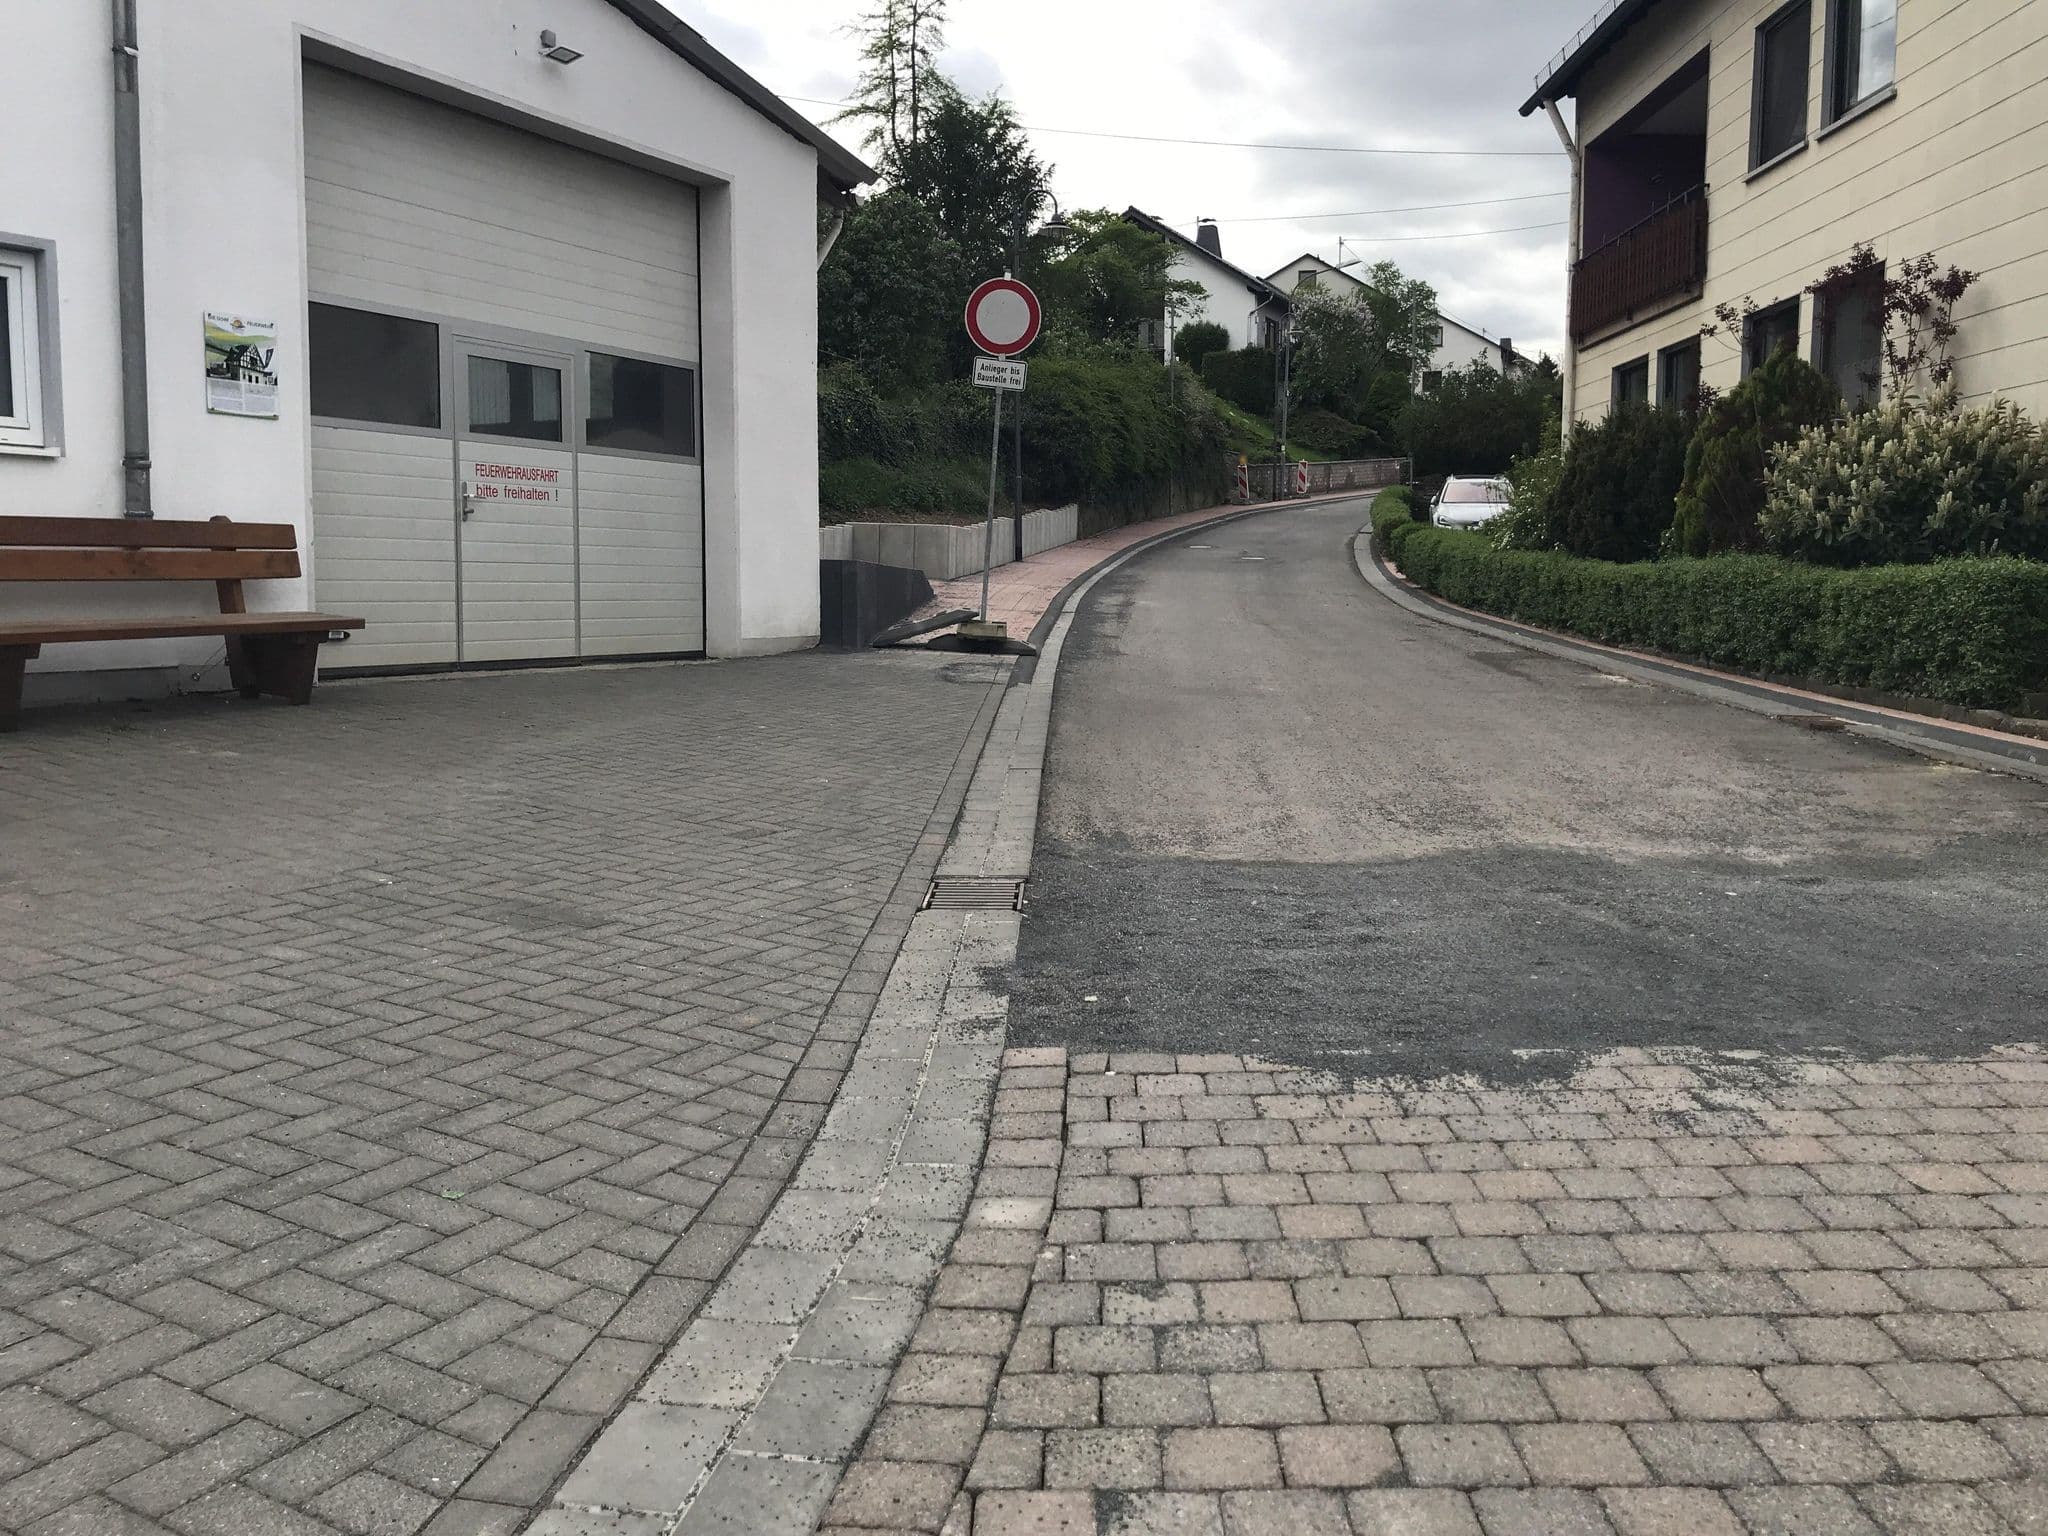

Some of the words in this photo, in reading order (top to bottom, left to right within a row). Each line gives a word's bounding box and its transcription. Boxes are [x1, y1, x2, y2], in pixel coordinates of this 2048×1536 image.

[980, 363, 1008, 374] Anlieger
[1010, 366, 1020, 375] bis
[977, 372, 1006, 384] Baustelle
[1010, 376, 1022, 386] frei
[476, 464, 558, 482] FEUERWEHRAUSFAHRT
[476, 483, 498, 498] bitte
[504, 485, 550, 501] freihalten
